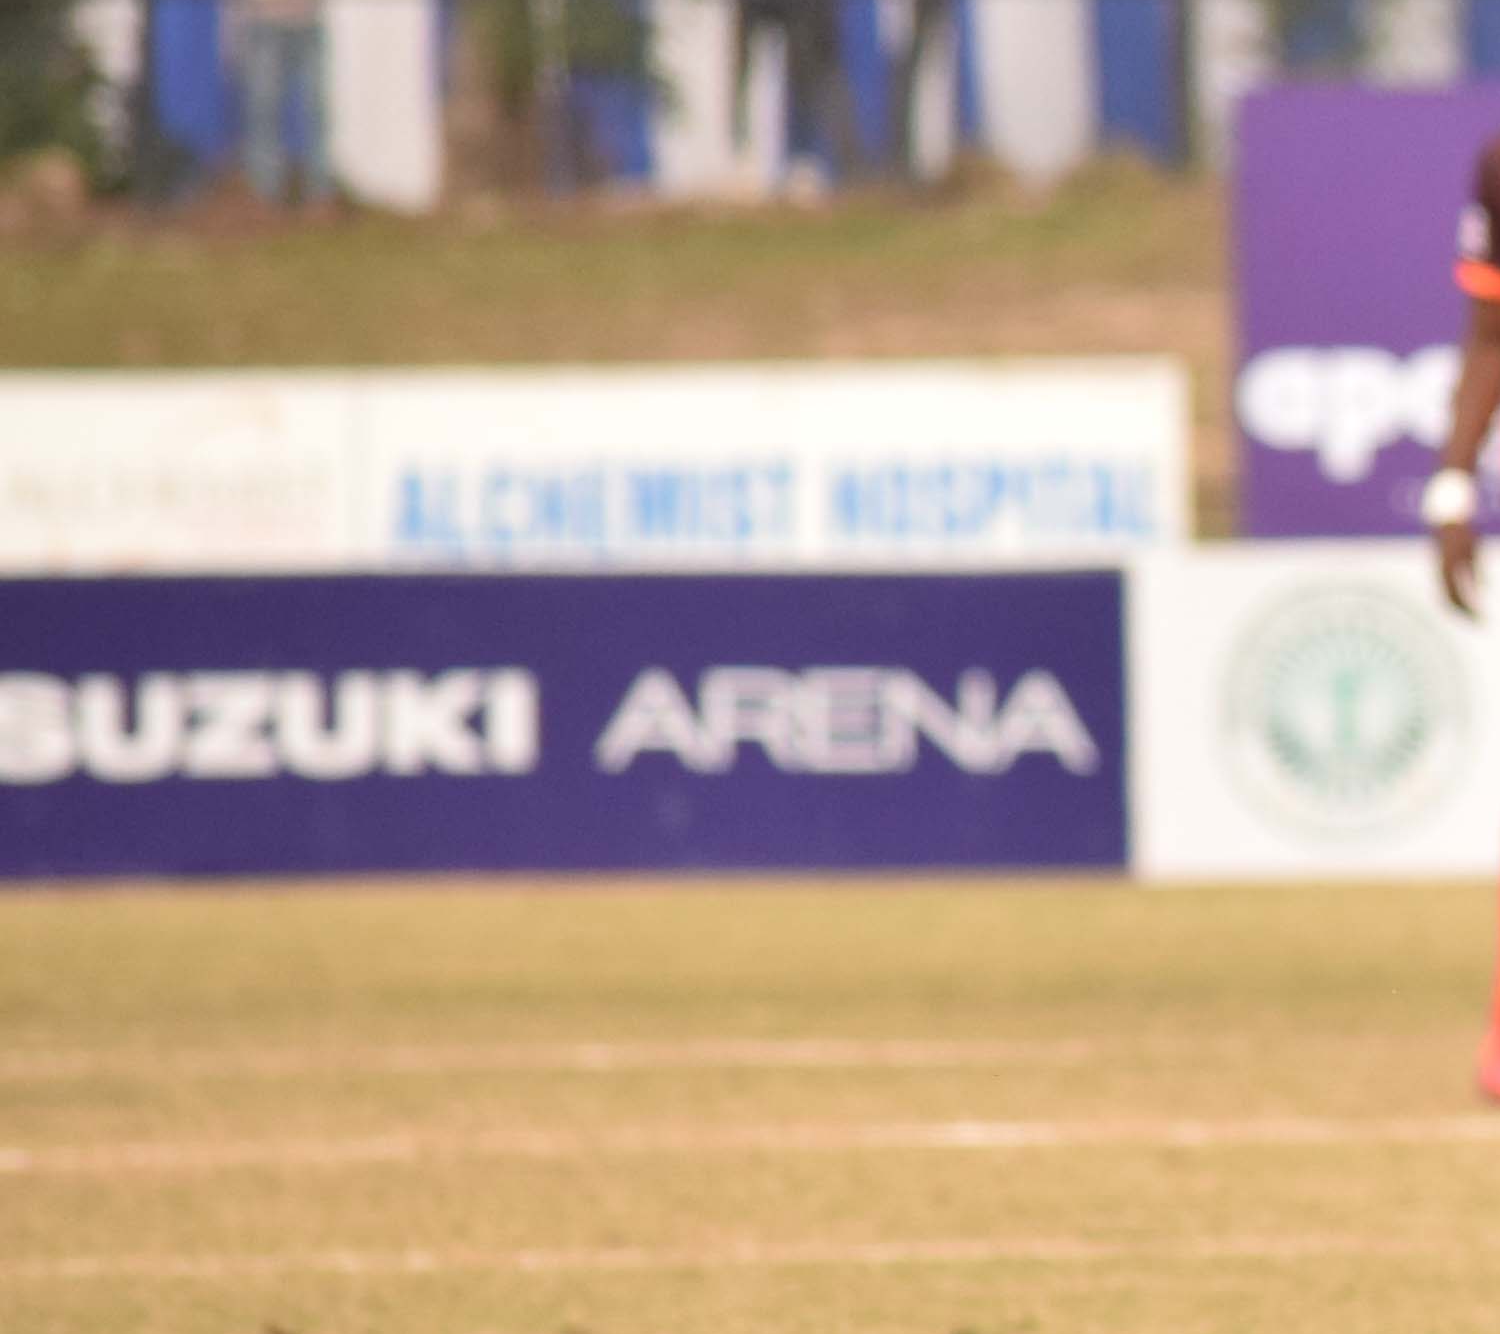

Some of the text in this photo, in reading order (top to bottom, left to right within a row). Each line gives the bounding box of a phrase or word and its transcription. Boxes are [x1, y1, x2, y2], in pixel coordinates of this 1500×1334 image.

[396, 450, 794, 543] ALCHEMIST
[828, 447, 1160, 543] HOSPITAL
[0, 665, 1101, 781] SUZUKI ARENA
